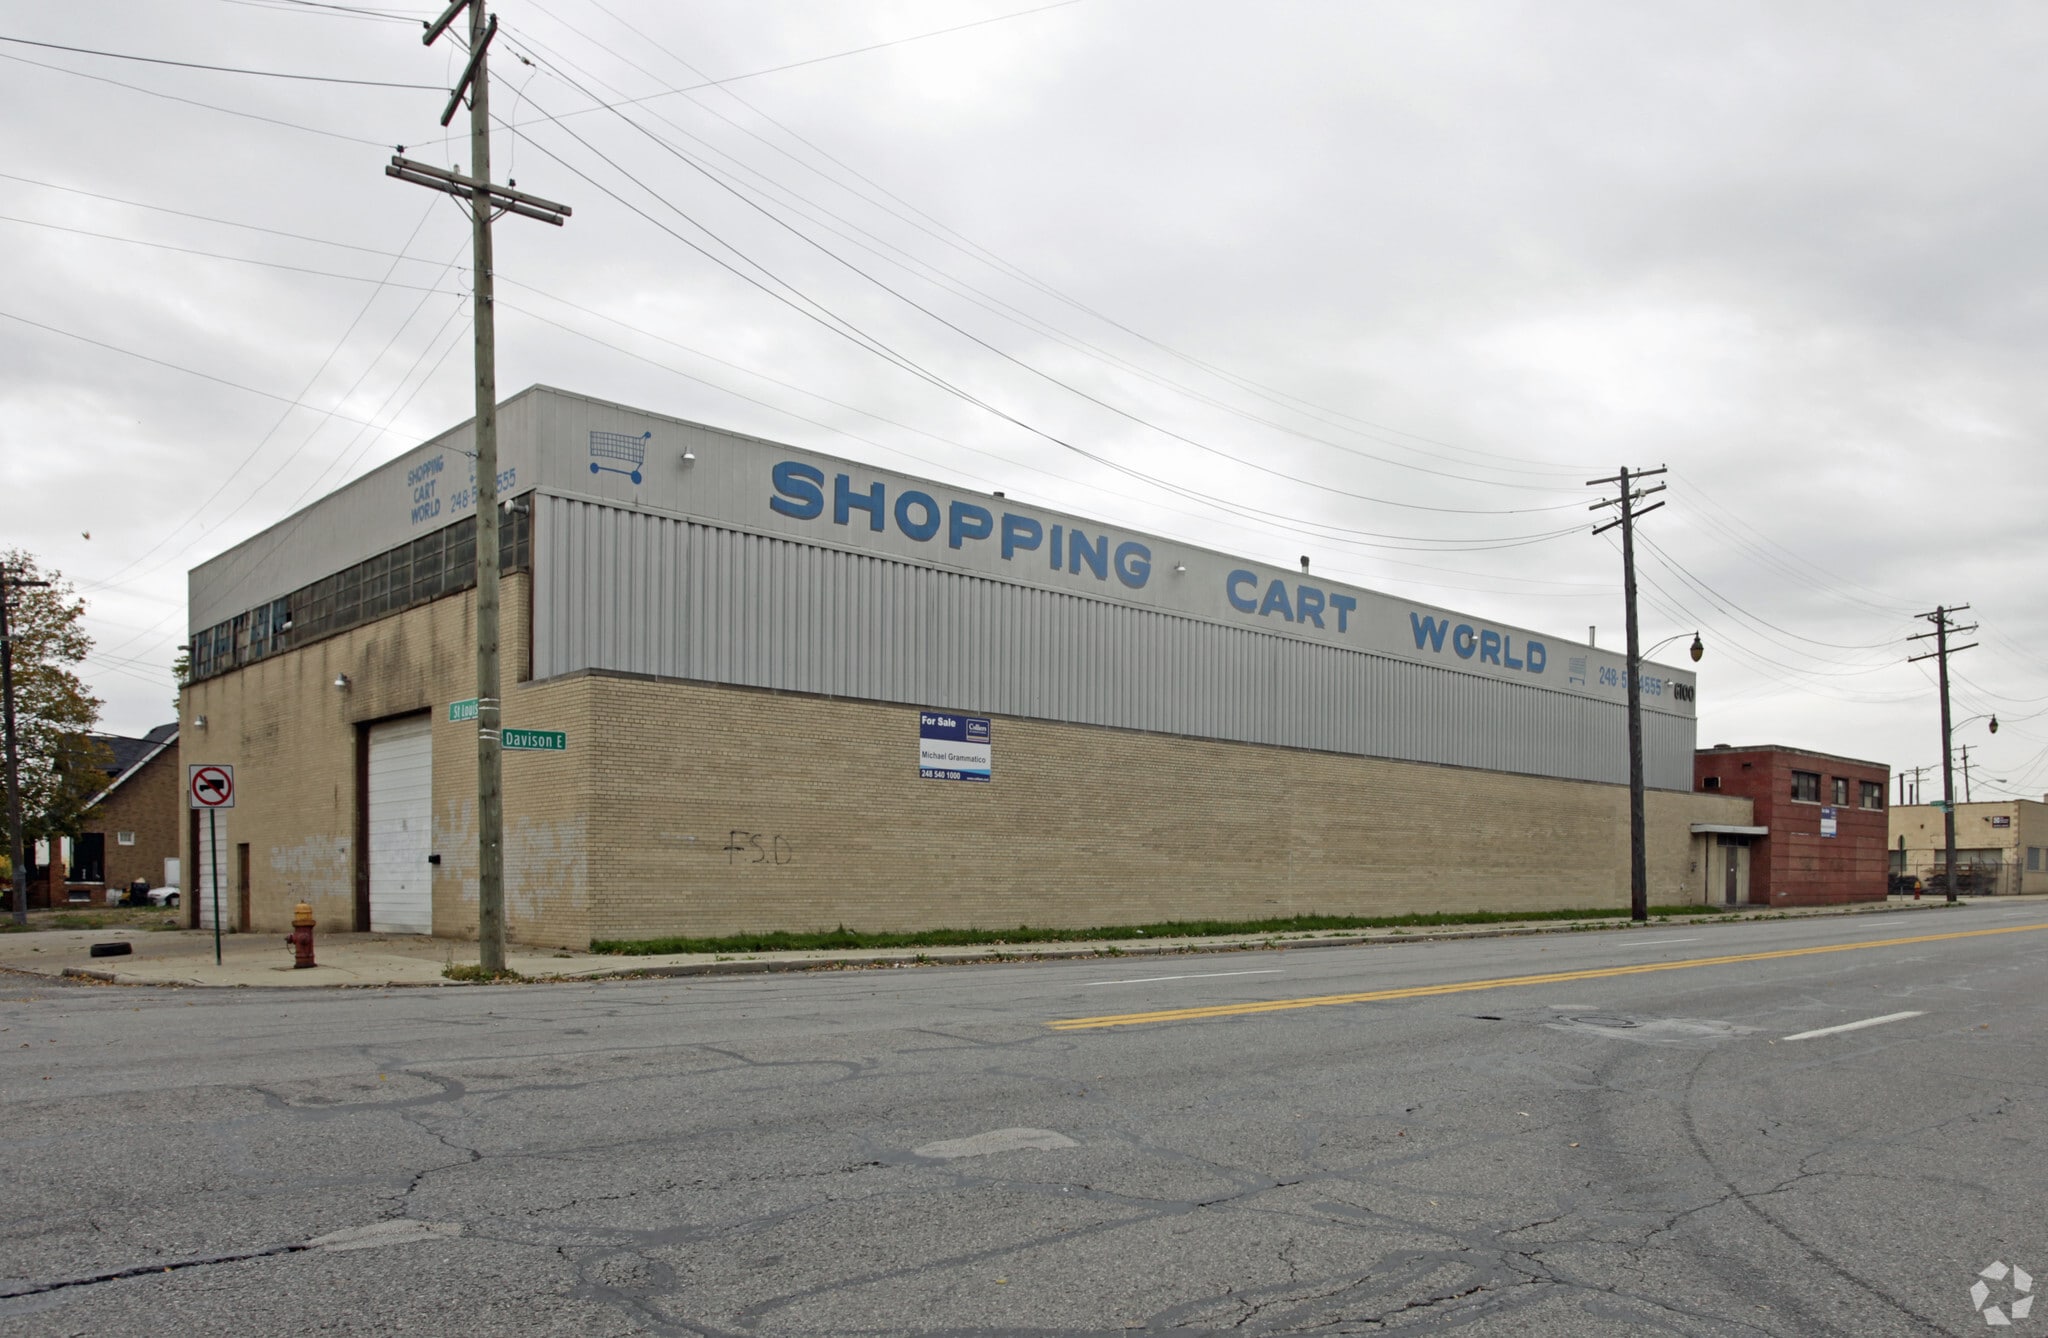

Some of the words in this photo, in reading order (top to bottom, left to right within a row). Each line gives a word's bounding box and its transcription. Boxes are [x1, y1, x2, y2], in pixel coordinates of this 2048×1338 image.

[407, 454, 444, 487] SHOPPING
[414, 479, 436, 504] CART
[411, 498, 440, 525] WORLD
[770, 460, 1151, 589] SHOPPING
[1226, 569, 1357, 633] CART
[1409, 611, 1547, 674] WORLD
[922, 715, 936, 726] For
[937, 717, 956, 728] Sale
[506, 732, 552, 748] Davison
[557, 735, 562, 748] E
[921, 751, 947, 760] Michael
[947, 753, 986, 764] Grammatico
